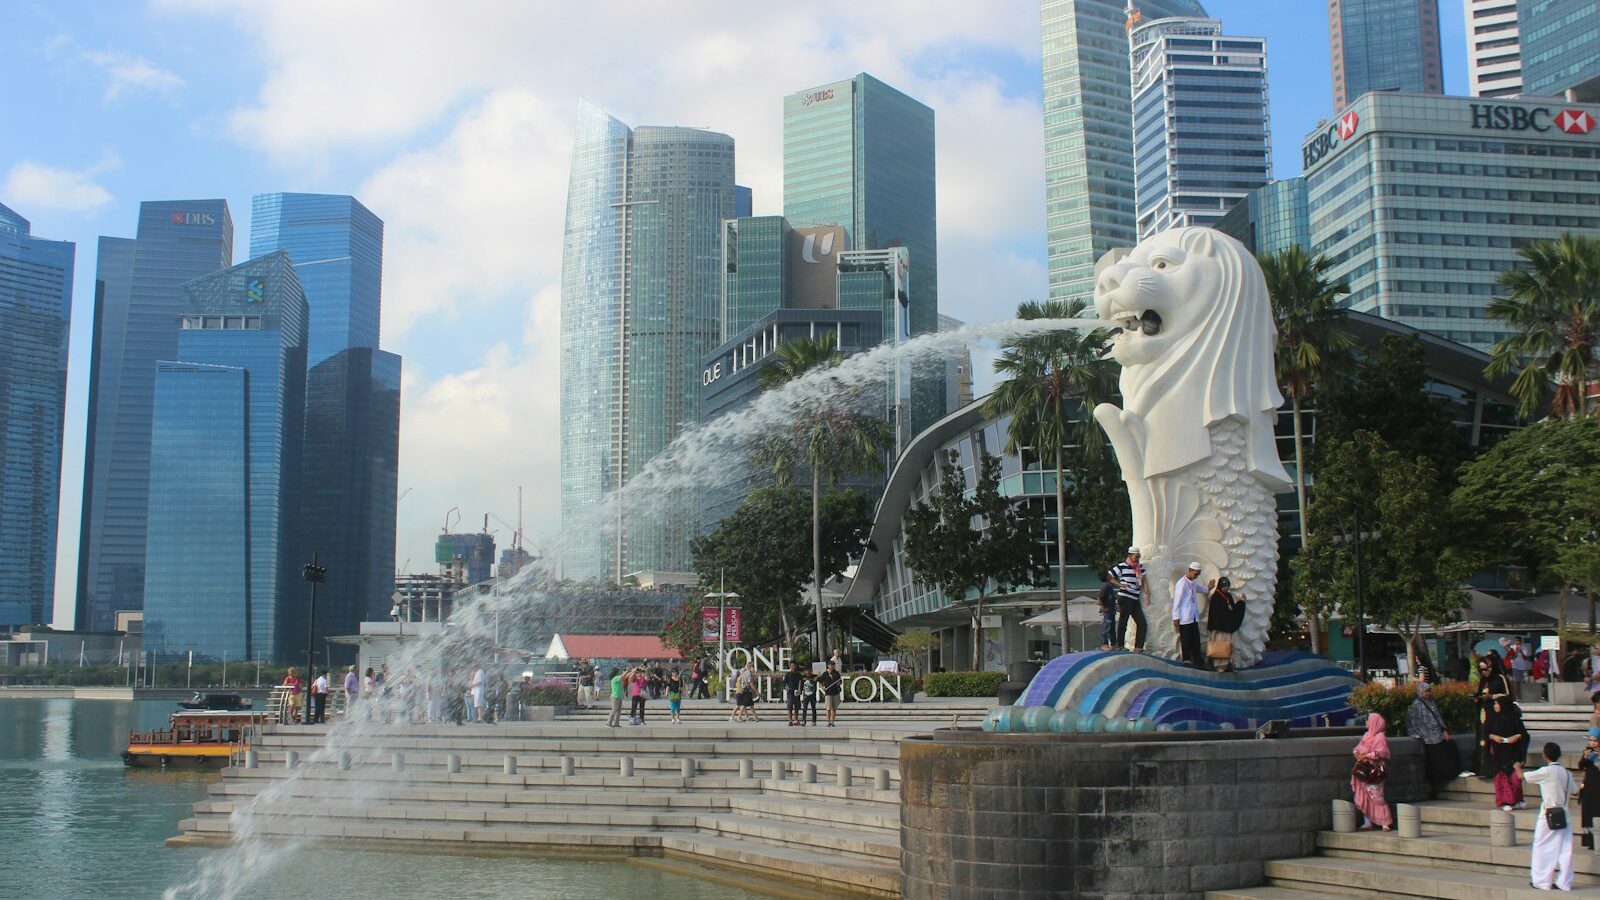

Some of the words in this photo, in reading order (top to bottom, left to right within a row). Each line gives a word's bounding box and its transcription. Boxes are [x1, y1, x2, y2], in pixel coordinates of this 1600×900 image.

[812, 90, 834, 102] UBS
[1469, 103, 1552, 132] HSBC
[1302, 123, 1338, 171] HSBC
[185, 212, 215, 225] DBS
[703, 362, 720, 386] OUE
[725, 647, 792, 672] ONE
